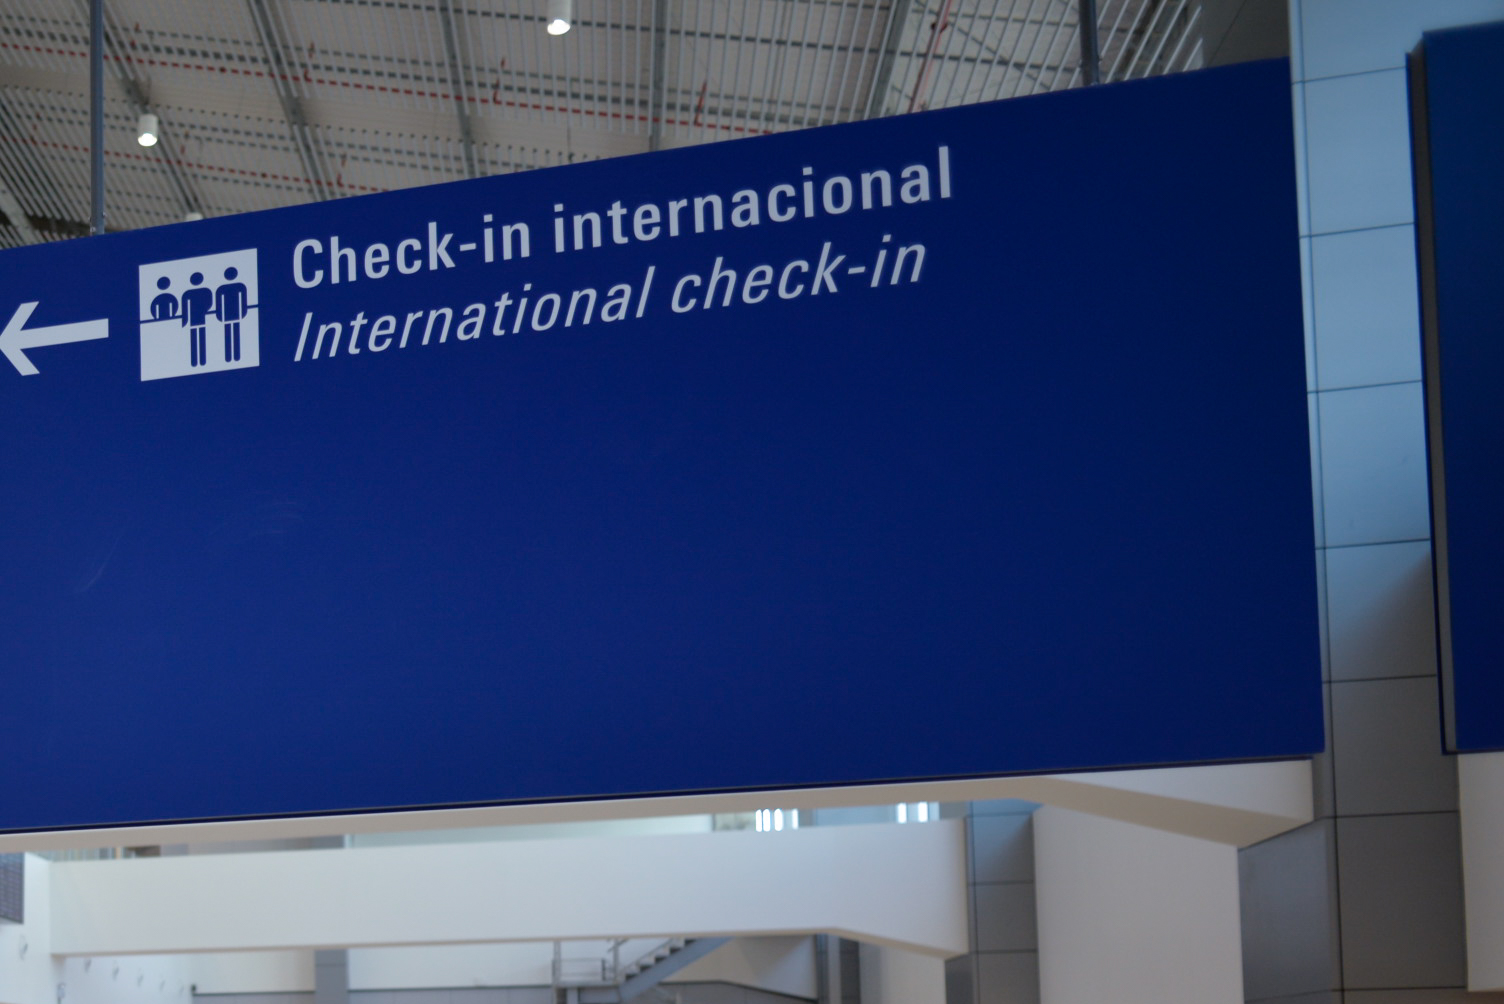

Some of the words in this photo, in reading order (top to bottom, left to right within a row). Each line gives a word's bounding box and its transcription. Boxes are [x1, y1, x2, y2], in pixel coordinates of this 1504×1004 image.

[294, 214, 531, 289] Check-in
[554, 146, 952, 253] internacional
[294, 265, 657, 362] International
[671, 234, 926, 314] check-in
